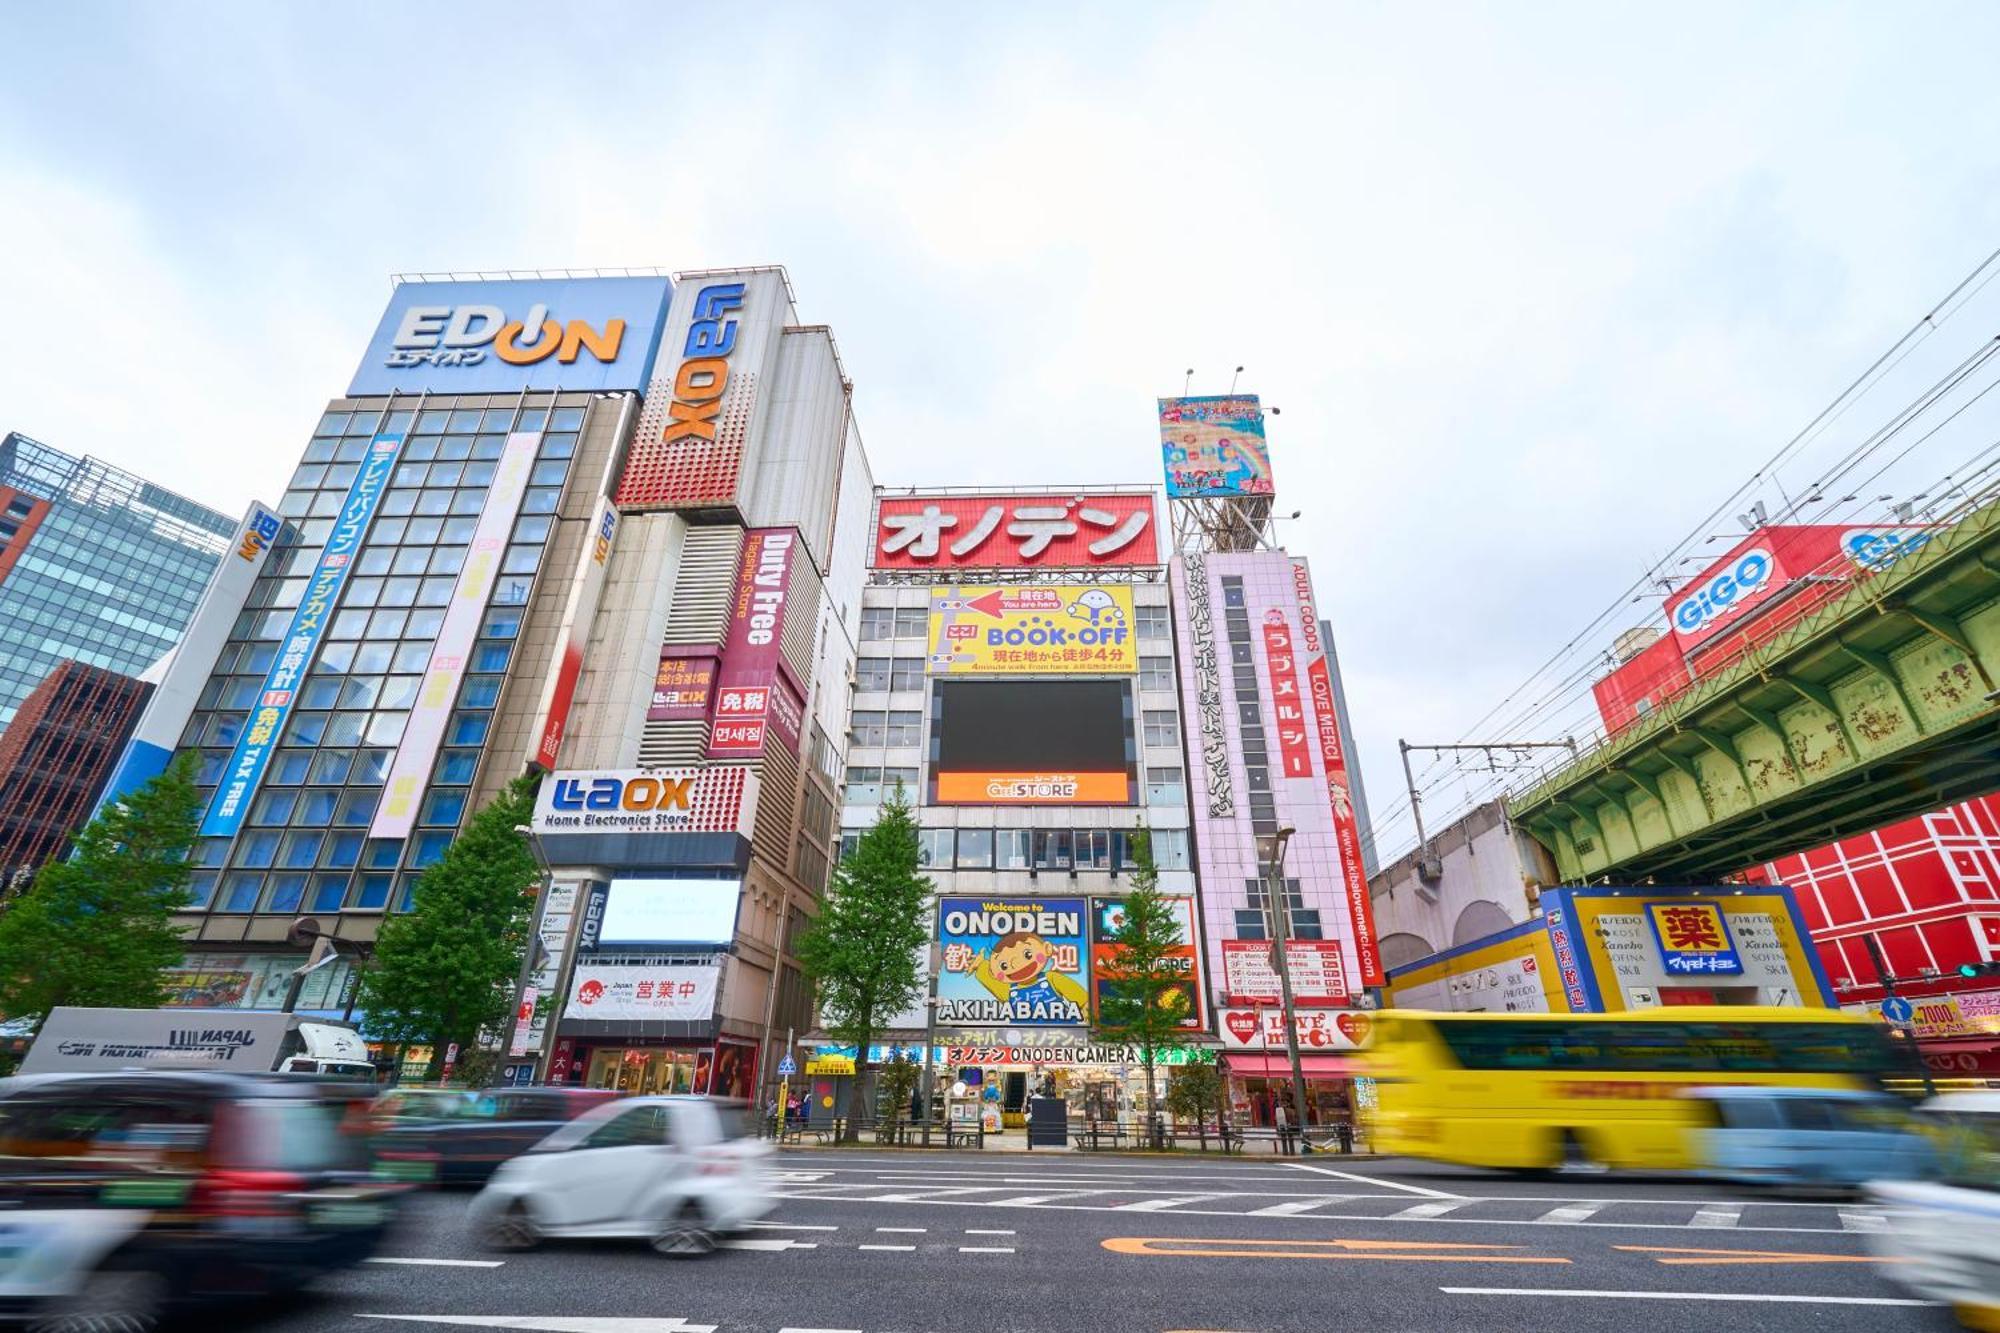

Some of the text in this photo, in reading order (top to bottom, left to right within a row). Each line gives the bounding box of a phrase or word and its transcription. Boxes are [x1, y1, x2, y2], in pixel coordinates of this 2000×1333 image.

[393, 303, 626, 365] EDION
[384, 348, 488, 368] エディオン
[880, 494, 1150, 559] オノデン
[736, 534, 762, 619] Flagship Store
[747, 533, 793, 645] Duty Free
[1019, 589, 1057, 600] 現在地
[1676, 552, 1768, 630] GiGO
[1003, 600, 1019, 608] You
[1037, 600, 1058, 609] here
[1293, 563, 1320, 652] ADULT GOODS
[993, 647, 1125, 662] 現在地から徒歩4分
[722, 693, 764, 711] 免税
[1268, 633, 1303, 771] ラブメルシー
[1311, 673, 1340, 760] LOVE MERCI
[715, 726, 760, 741] 면세점
[219, 747, 260, 817] TAX FREE
[545, 813, 689, 827] Home Electronics Store
[982, 902, 1043, 913] Welcome to
[1340, 827, 1376, 978] www.akibalovemerci.com
[945, 911, 1079, 935] ONODEN
[1661, 907, 1721, 949] 薬
[1600, 941, 1643, 950] Kanebo
[636, 980, 696, 999] 営業中
[939, 1000, 1084, 1021] AKIHABARA
[950, 1047, 1006, 1062] オノデン
[1011, 1048, 1073, 1063] ONODEN
[1075, 1048, 1136, 1065] CAMERA
